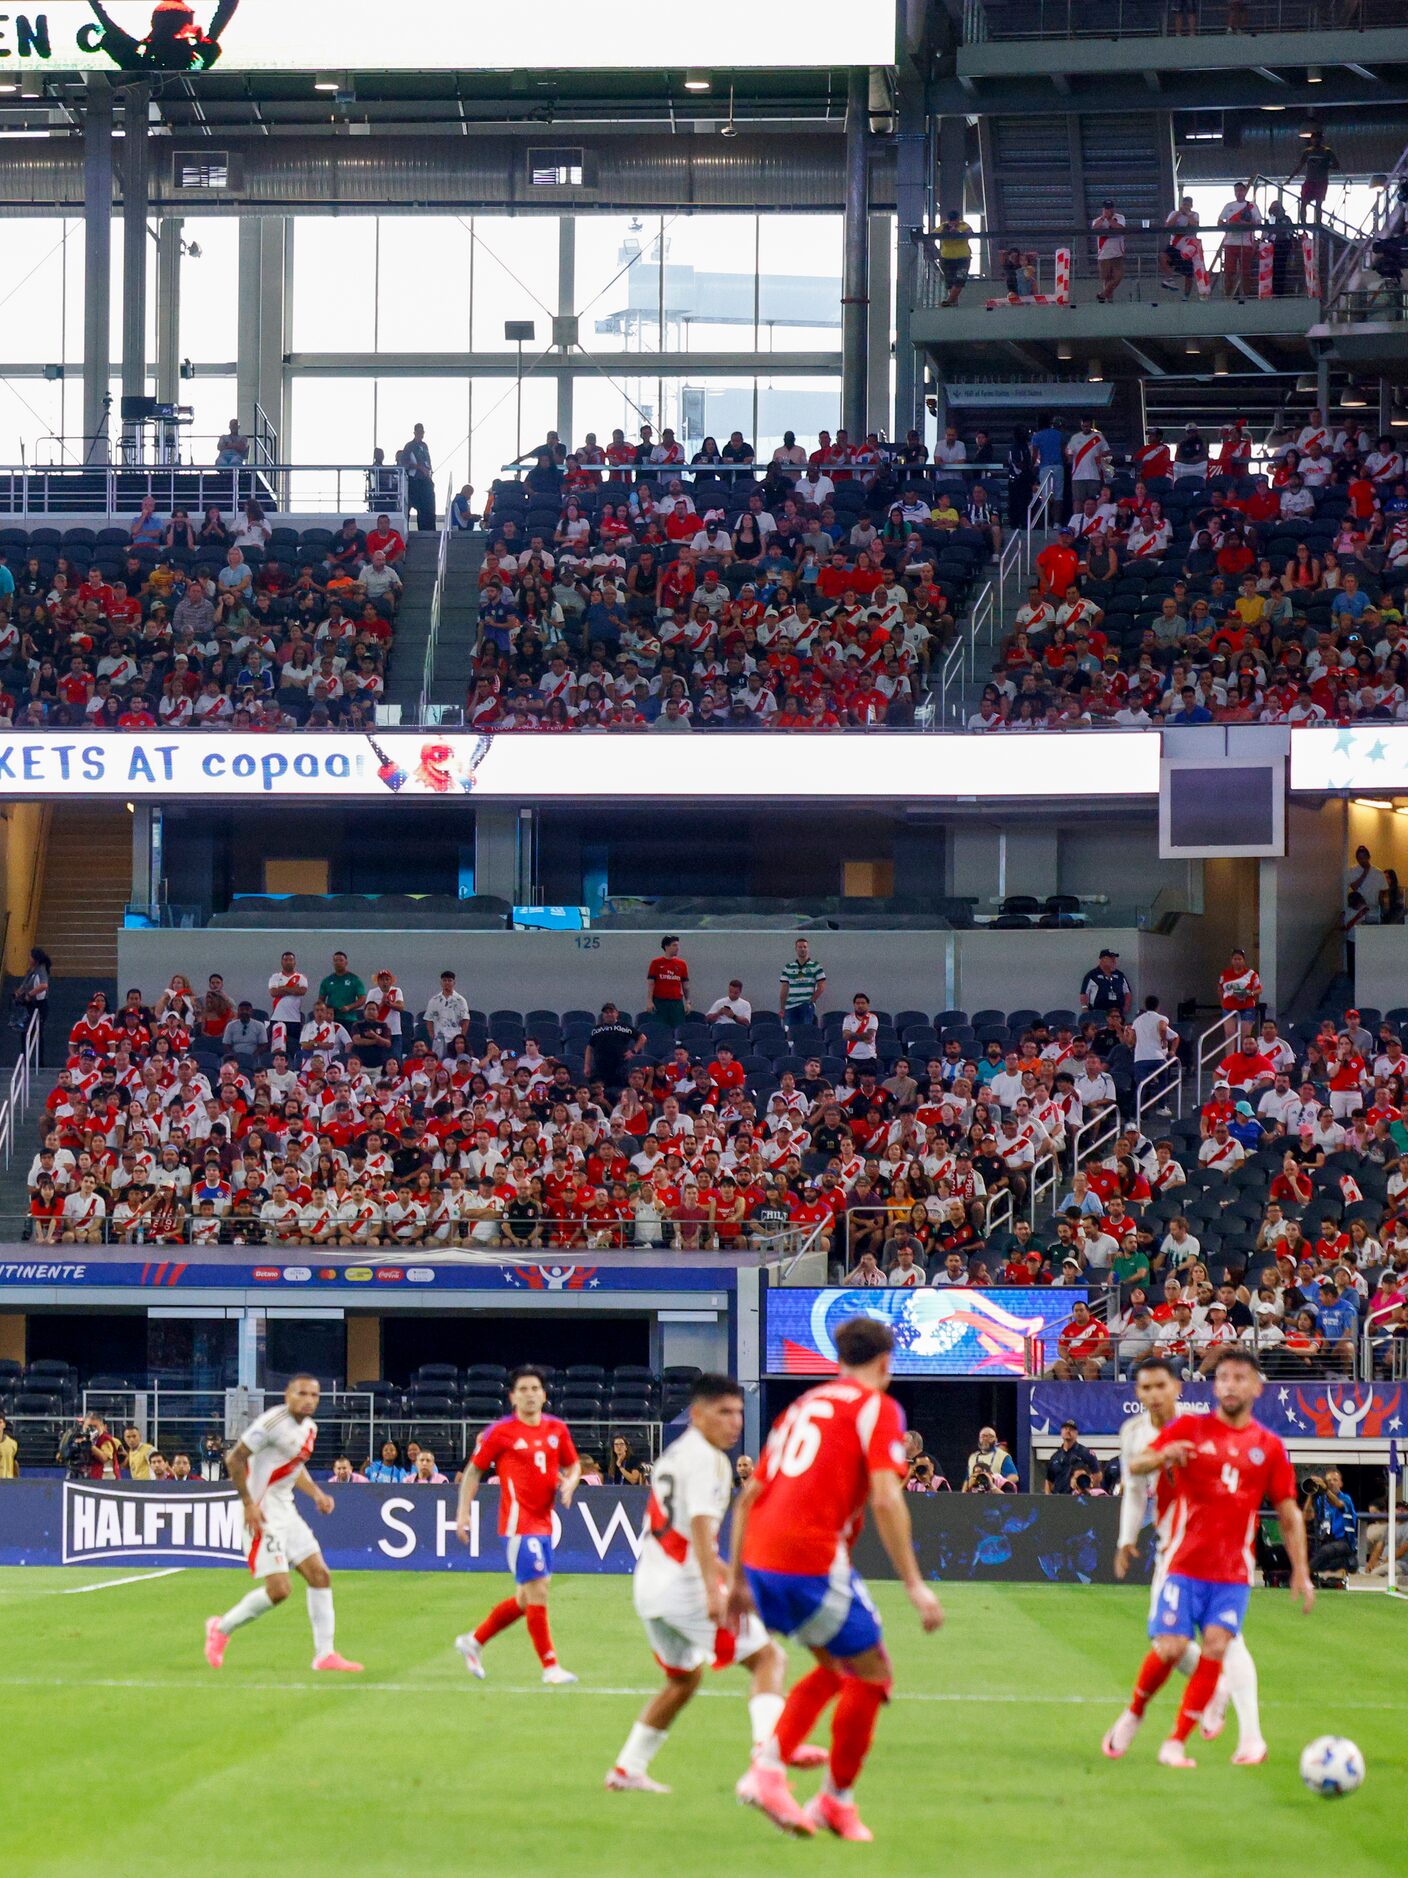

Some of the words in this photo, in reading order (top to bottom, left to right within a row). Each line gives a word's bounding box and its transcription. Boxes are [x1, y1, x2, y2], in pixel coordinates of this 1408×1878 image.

[127, 746, 181, 783] AT
[574, 936, 601, 949] 125
[591, 1026, 613, 1036] Calvin
[613, 1025, 633, 1035] Klein
[534, 1451, 546, 1474] 9
[1220, 1463, 1240, 1495] 4
[378, 1497, 649, 1561] SHW
[1162, 1583, 1181, 1611] 4
